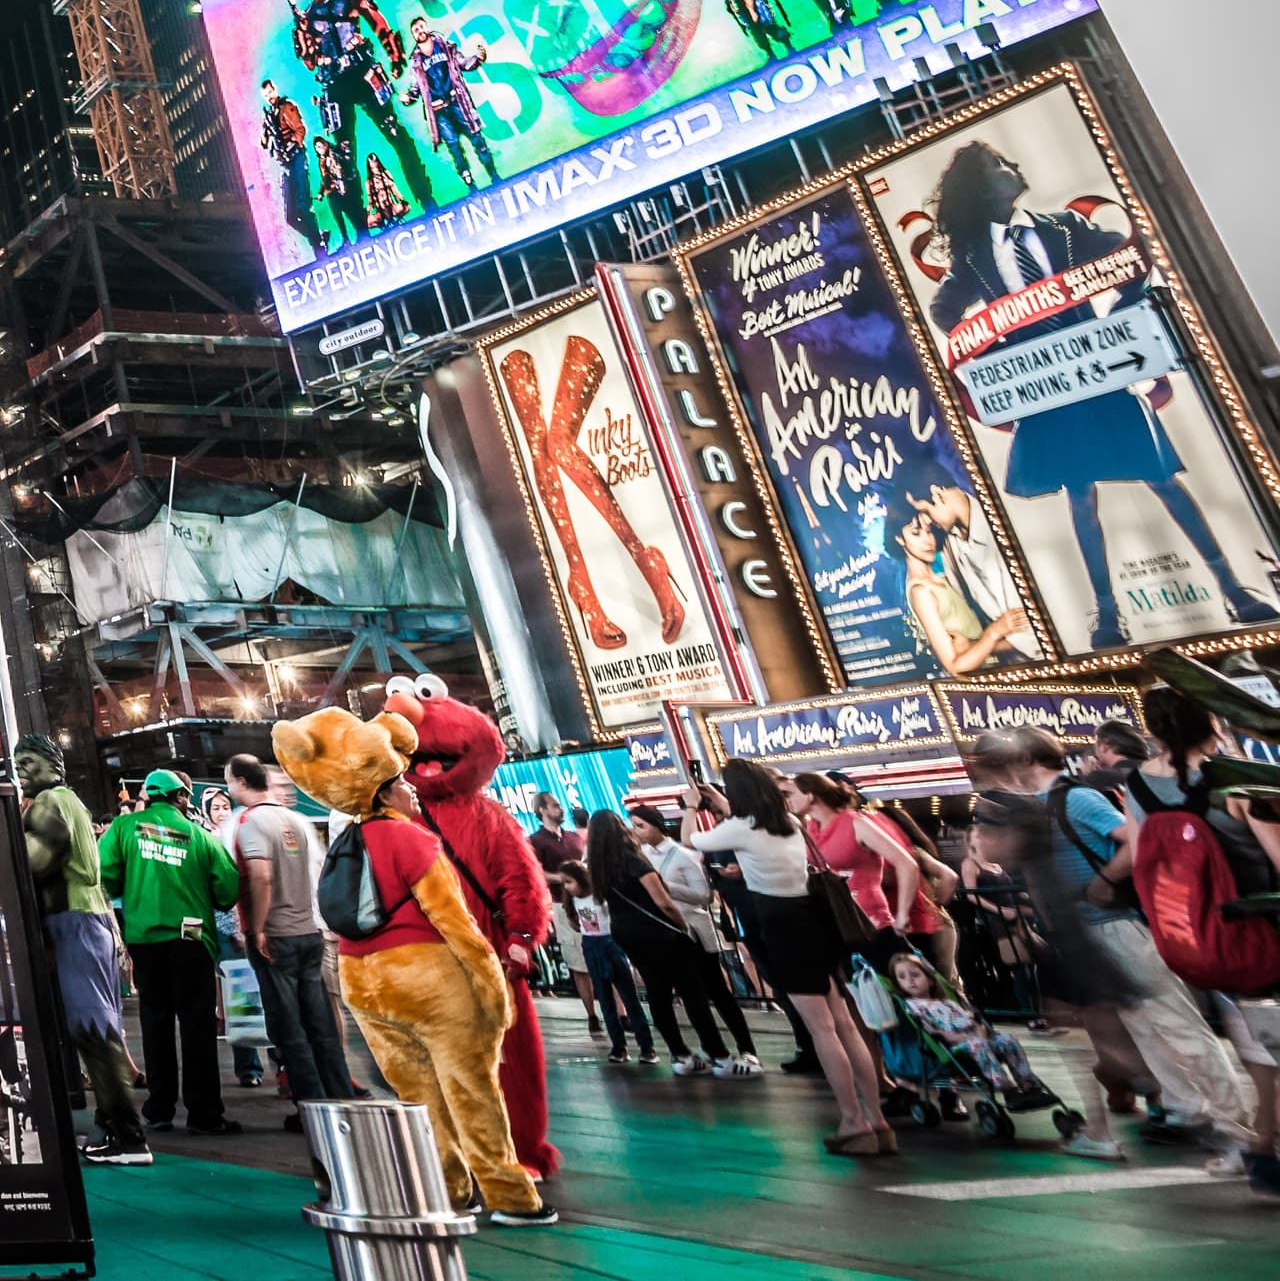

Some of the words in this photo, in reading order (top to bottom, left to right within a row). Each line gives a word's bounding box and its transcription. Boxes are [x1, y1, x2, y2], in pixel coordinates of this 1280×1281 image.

[283, 226, 433, 309] EXPERIENCE
[434, 215, 456, 246] IT
[461, 198, 497, 237] IN
[500, 140, 637, 218] IMAX
[640, 101, 725, 161] 3D
[728, 35, 866, 124] NOW
[729, 211, 821, 283] Winner!
[1099, 244, 1142, 274] BEFORE
[742, 277, 757, 303] 4
[757, 265, 783, 292] TONY
[783, 252, 826, 283] AWARDS
[1069, 264, 1137, 302] JANUARY
[1138, 259, 1148, 274] 1
[739, 298, 787, 340] Best
[786, 267, 862, 319] Musical!
[949, 315, 991, 360] FINAL
[994, 281, 1066, 335] MONTHS
[323, 330, 343, 350] city
[343, 322, 379, 343] outdoor
[969, 346, 1052, 390] PEDESTRIAN
[1054, 332, 1093, 365] FLOW
[1095, 318, 1138, 350] ZONE
[770, 336, 820, 408] An
[979, 388, 1013, 416] KEEP
[1015, 371, 1072, 405] MOVING
[646, 285, 778, 599] PALACE
[761, 374, 937, 476] American
[606, 445, 656, 486] Boots
[810, 430, 904, 513] Paris
[1125, 580, 1214, 616] Matilda
[591, 658, 635, 683] WINNER!
[644, 650, 675, 673] TONY
[596, 678, 645, 696] INCLUDING
[645, 672, 673, 688] BEST
[733, 722, 756, 757] An
[756, 716, 840, 756] American
[839, 705, 892, 743] Paris
[962, 698, 986, 728] An
[985, 694, 1065, 735] American
